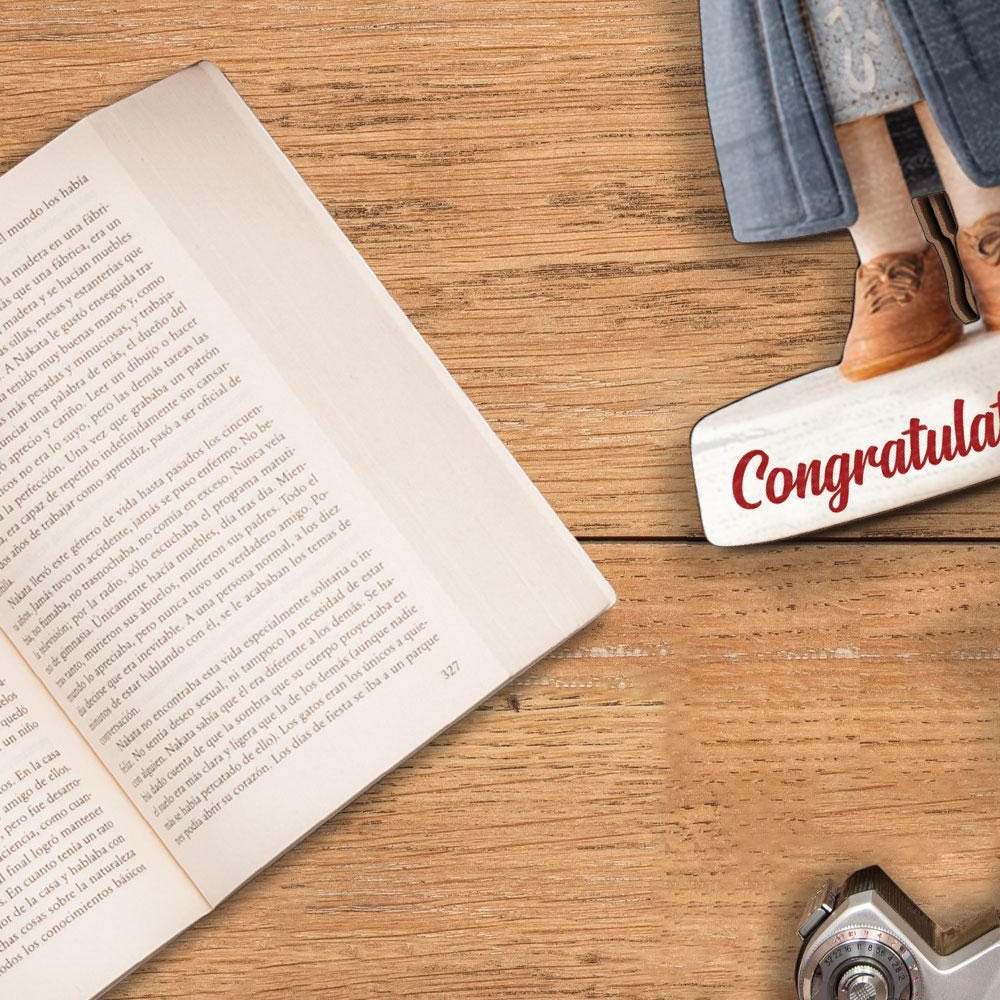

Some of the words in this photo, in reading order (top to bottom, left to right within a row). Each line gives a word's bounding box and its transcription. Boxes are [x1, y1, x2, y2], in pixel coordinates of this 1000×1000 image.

[440, 660, 459, 679] 327
[844, 944, 852, 953] 16
[856, 943, 862, 952] 11
[867, 943, 873, 952] 8
